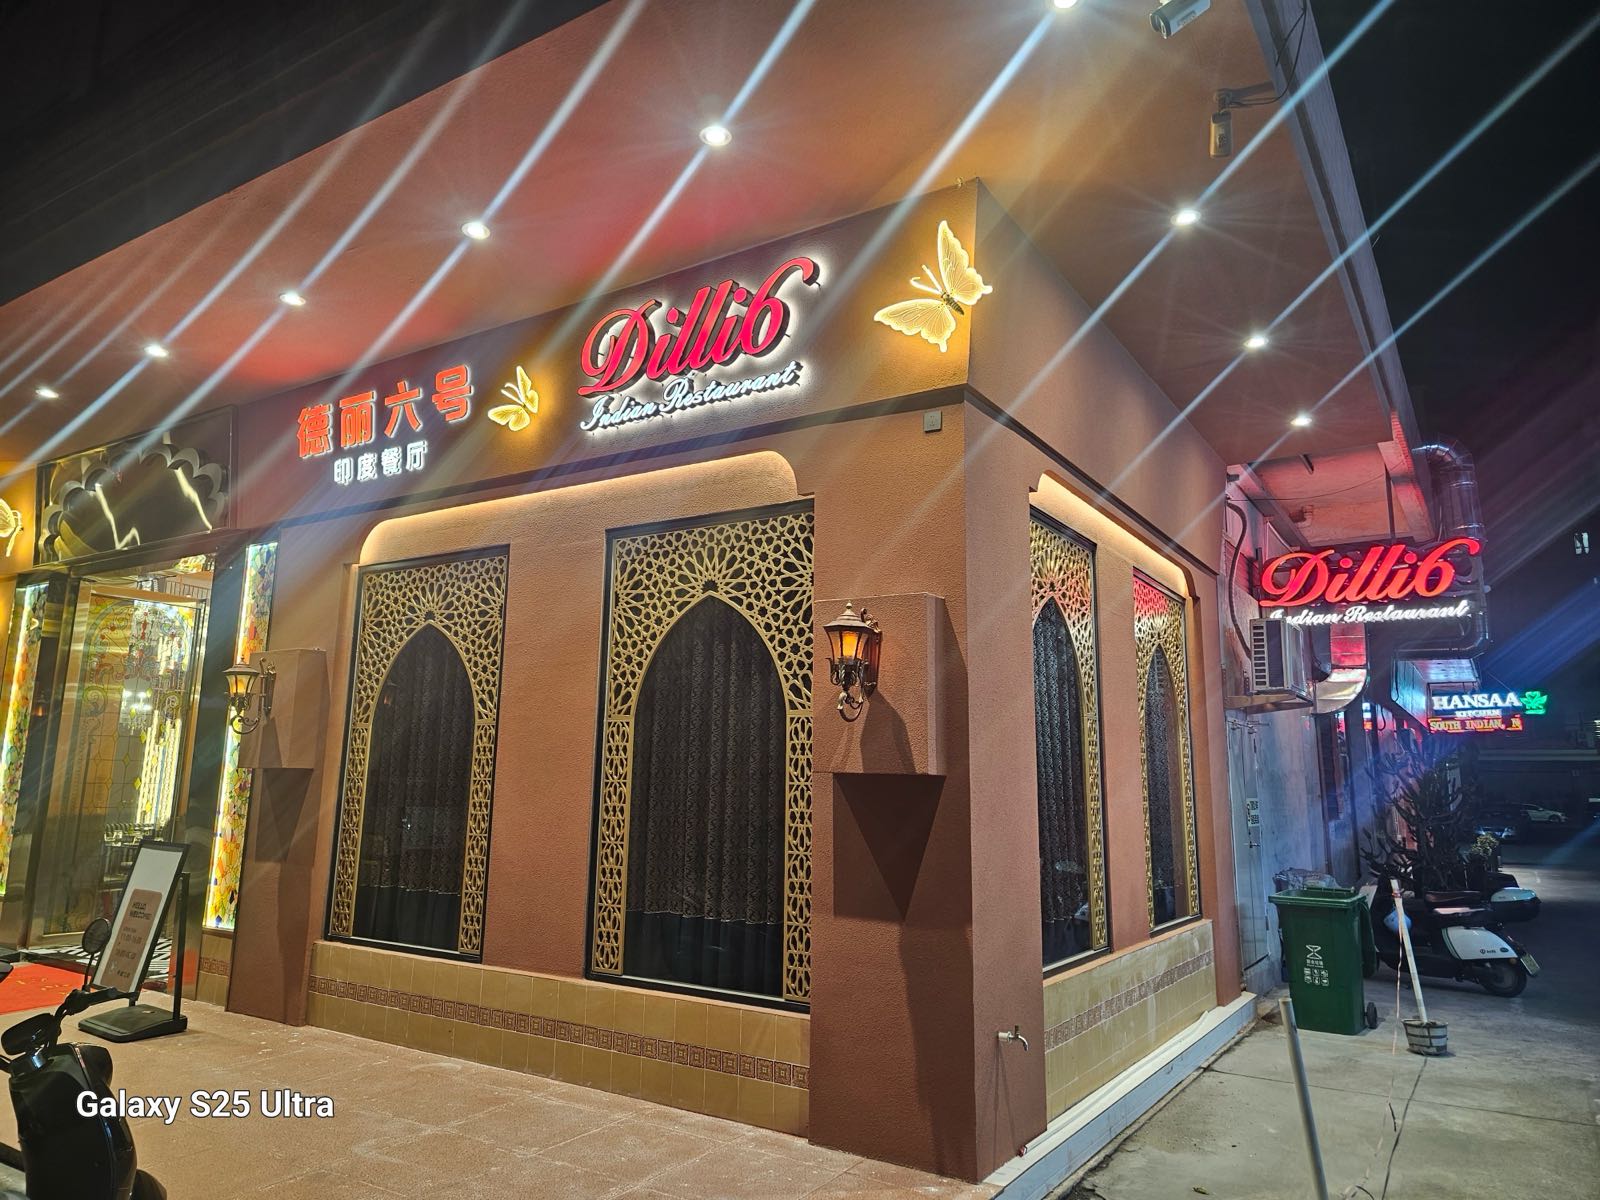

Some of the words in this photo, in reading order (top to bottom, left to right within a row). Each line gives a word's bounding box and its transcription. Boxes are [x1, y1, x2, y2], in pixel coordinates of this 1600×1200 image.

[578, 257, 821, 397] Dilli6
[297, 365, 473, 458] 德丽六号
[580, 395, 661, 431] Indian
[663, 361, 804, 415] Restaurant
[334, 441, 427, 485] 印度餐厅
[1259, 537, 1481, 608] Dilli6
[1344, 600, 1471, 624] Restaurant
[1430, 720, 1462, 731] SOUTH
[1432, 692, 1522, 710] HANSAA
